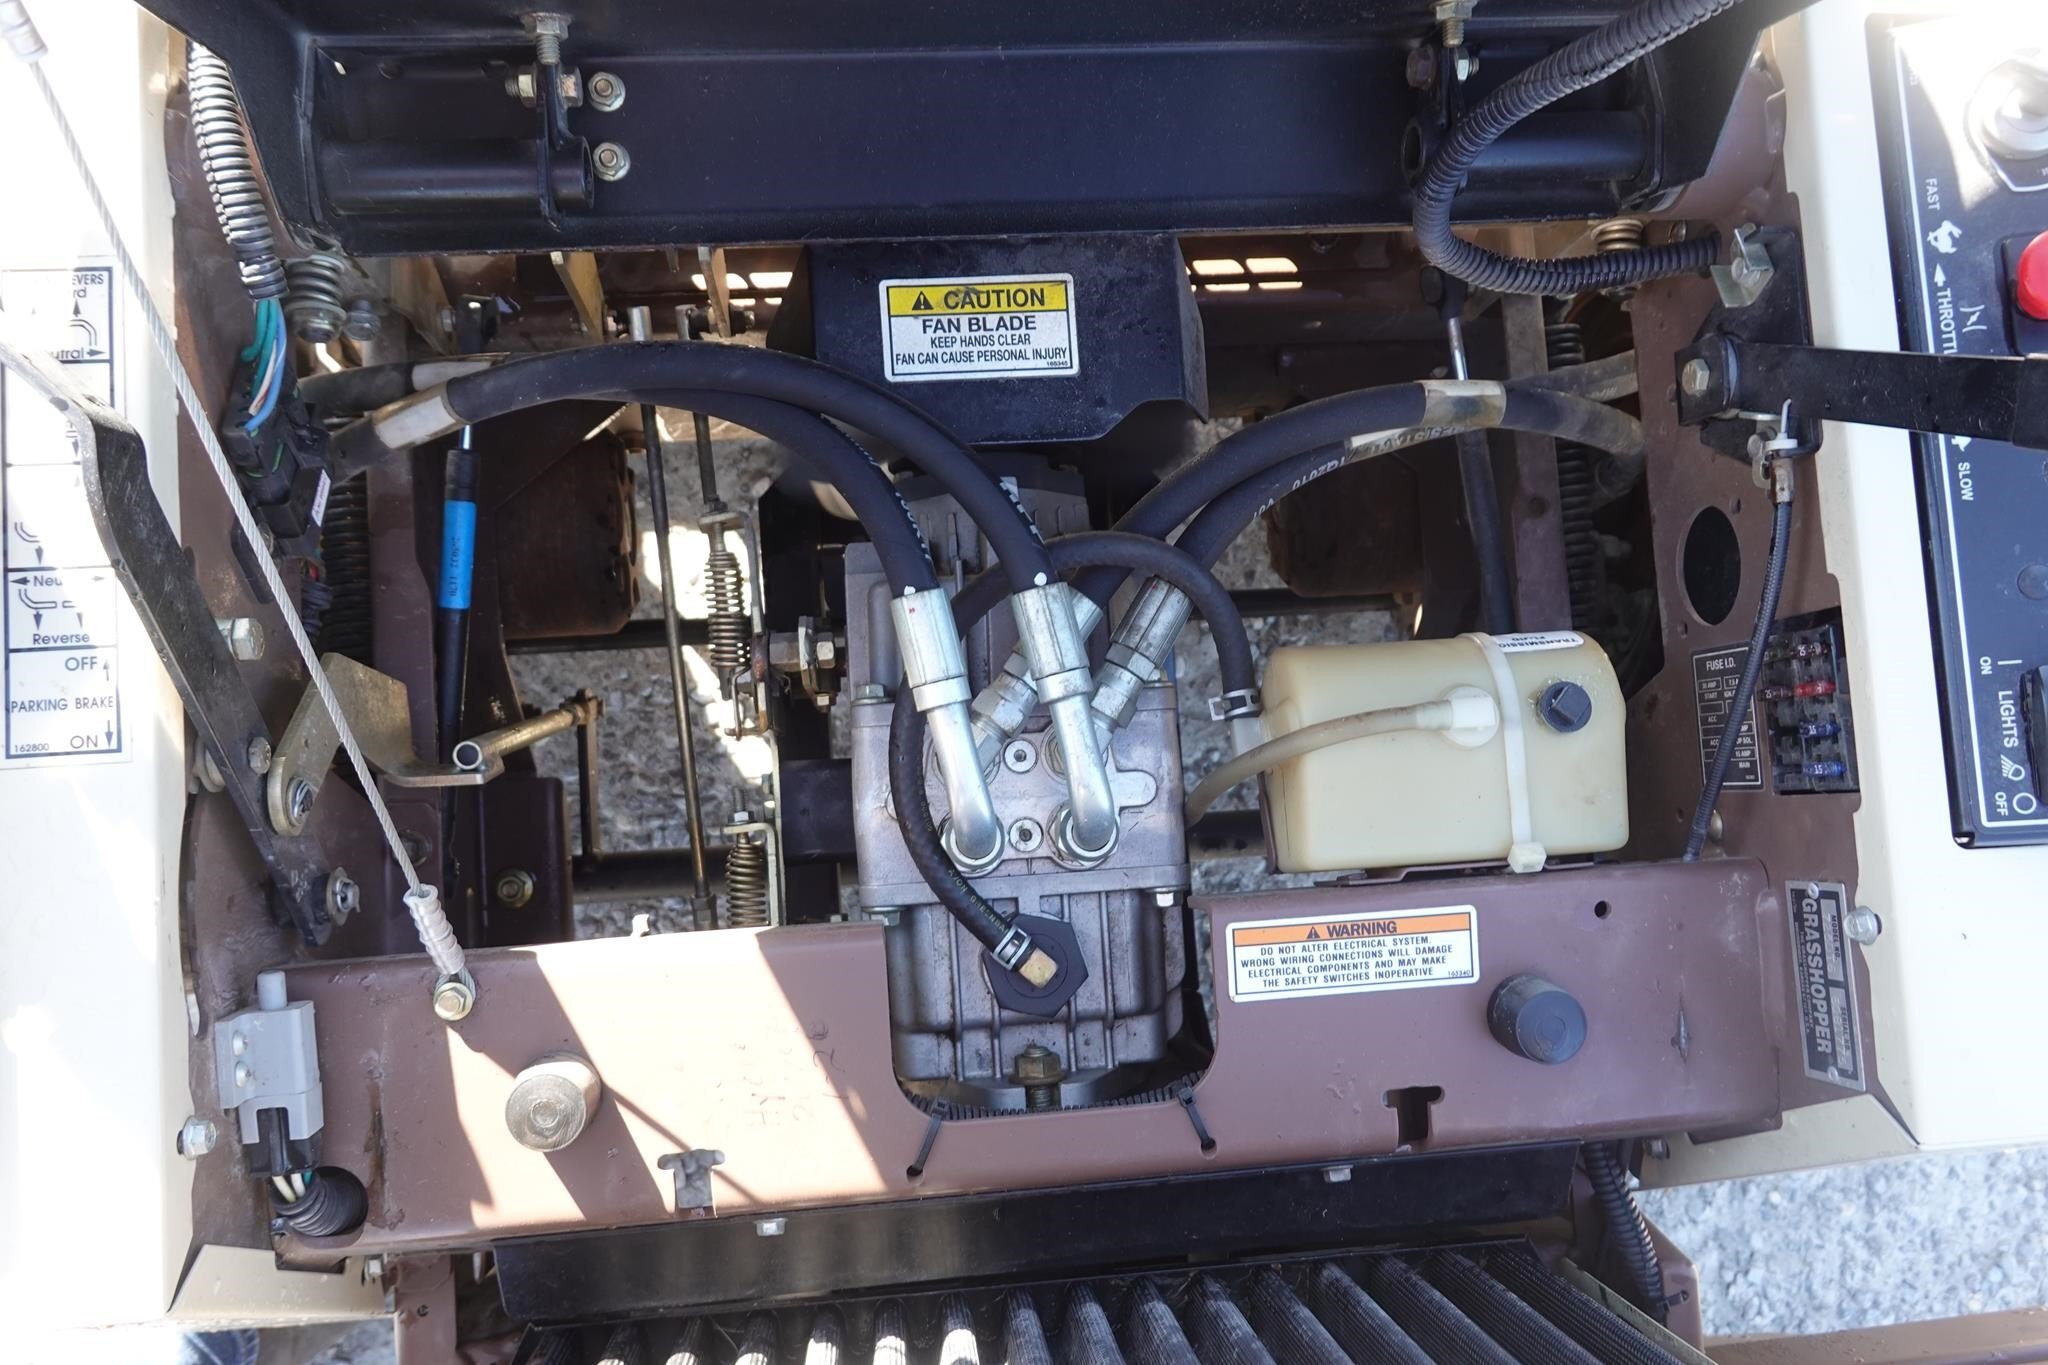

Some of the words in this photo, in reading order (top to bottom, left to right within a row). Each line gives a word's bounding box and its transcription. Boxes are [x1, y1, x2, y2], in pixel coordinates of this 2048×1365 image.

[1925, 177, 1941, 211] FAST
[72, 273, 105, 286] EVERS
[943, 288, 1046, 310] CAUTION
[922, 318, 961, 334] FAN
[968, 315, 1037, 333] BLADE
[1937, 287, 1958, 354] THROTT
[930, 335, 957, 349] KEEP
[960, 335, 995, 348] HANDS
[998, 333, 1031, 346] CLEAR
[52, 347, 85, 359] utral
[895, 353, 915, 366] FAN
[917, 352, 939, 365] CAN
[941, 351, 975, 364] CAUSE
[977, 348, 1030, 362] PERSONAL
[1032, 347, 1067, 360] INJURY
[1957, 461, 1974, 502] SLOW
[32, 633, 91, 645] Reverse
[1498, 638, 1576, 648] TRANSMISSIO
[65, 656, 98, 671] OFF
[1706, 658, 1724, 671] FUSE
[1724, 657, 1736, 669] I.D.
[1979, 656, 1992, 676] ON
[11, 698, 68, 713] PARKING
[75, 696, 114, 710] BRAKE
[1998, 691, 2019, 748] LIGHTS
[14, 742, 50, 753] 162800
[69, 734, 99, 749] ON
[1814, 765, 1823, 775] 15
[1994, 791, 2009, 817] OFF
[1326, 921, 1397, 938] WARNING
[1831, 914, 1840, 946] MODEL
[1260, 947, 1274, 956] DO
[1278, 946, 1296, 955] NOT
[1301, 943, 1328, 954] ALTER
[1333, 940, 1387, 951] ELECTRICAL
[1392, 936, 1432, 946] SYSTEM.
[1241, 958, 1275, 968] WRONG
[1280, 955, 1314, 965] WIRING
[1319, 950, 1383, 963] CONNECTIONS
[1388, 947, 1410, 957] WILL
[1415, 944, 1453, 956] DAMAGE
[1248, 966, 1302, 979] ELECTRICAL
[1307, 962, 1370, 974] COMPONENTS
[1375, 959, 1393, 969] AND
[1398, 957, 1416, 967] MAY
[1421, 955, 1447, 965] MAKE
[1801, 897, 1833, 1054] GRASSHOPPER
[1263, 978, 1280, 988] THE
[1284, 975, 1318, 986] SAFETY
[1323, 971, 1370, 984] SWITCHES
[1375, 967, 1434, 979] INOPERATIVE
